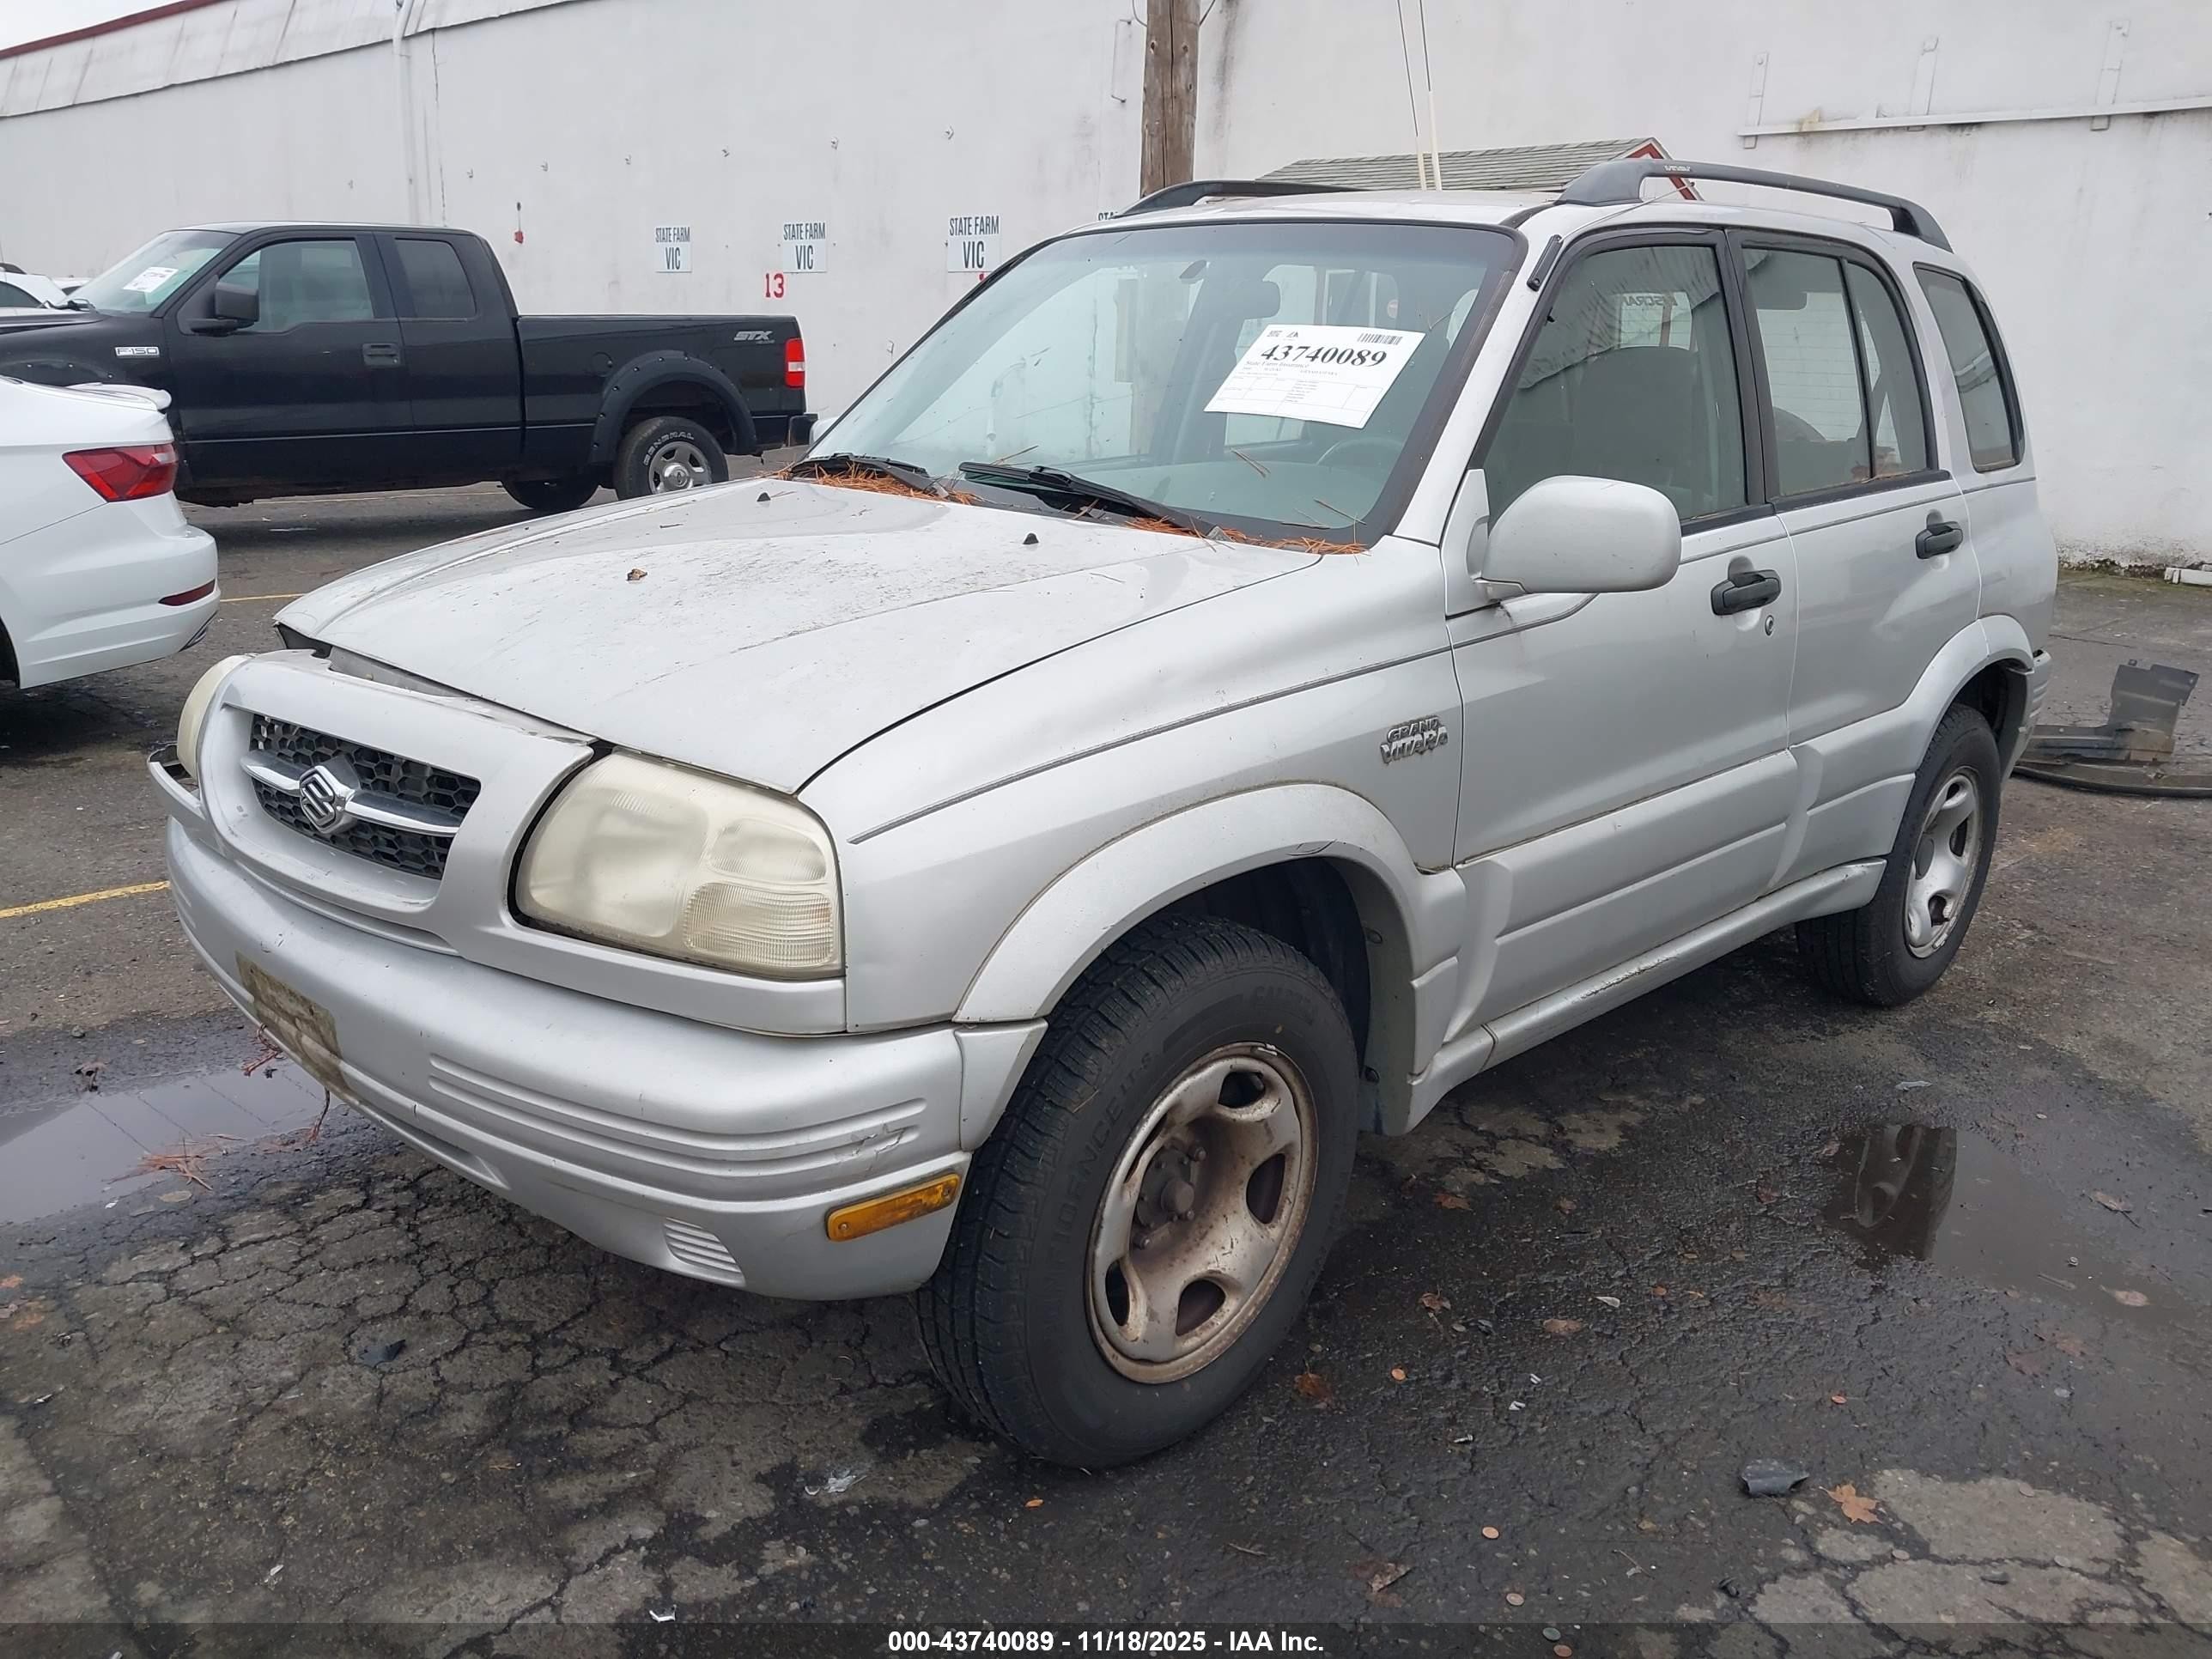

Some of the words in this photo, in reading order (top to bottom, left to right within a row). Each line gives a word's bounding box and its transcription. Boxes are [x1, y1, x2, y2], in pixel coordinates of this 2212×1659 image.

[655, 227, 672, 242] STATE
[673, 226, 690, 242] FARM
[783, 223, 804, 240] STATE
[805, 222, 826, 240] FARM
[949, 216, 973, 236] STATE
[975, 215, 1000, 235] FARM
[665, 246, 681, 270] VIC
[795, 244, 814, 270] VIC
[963, 240, 985, 269] VIC
[765, 273, 785, 298] 13
[733, 331, 773, 341] STX
[1261, 343, 1388, 368] 43740089
[1387, 715, 1441, 743] GRAND
[1379, 726, 1448, 764] VITARA
